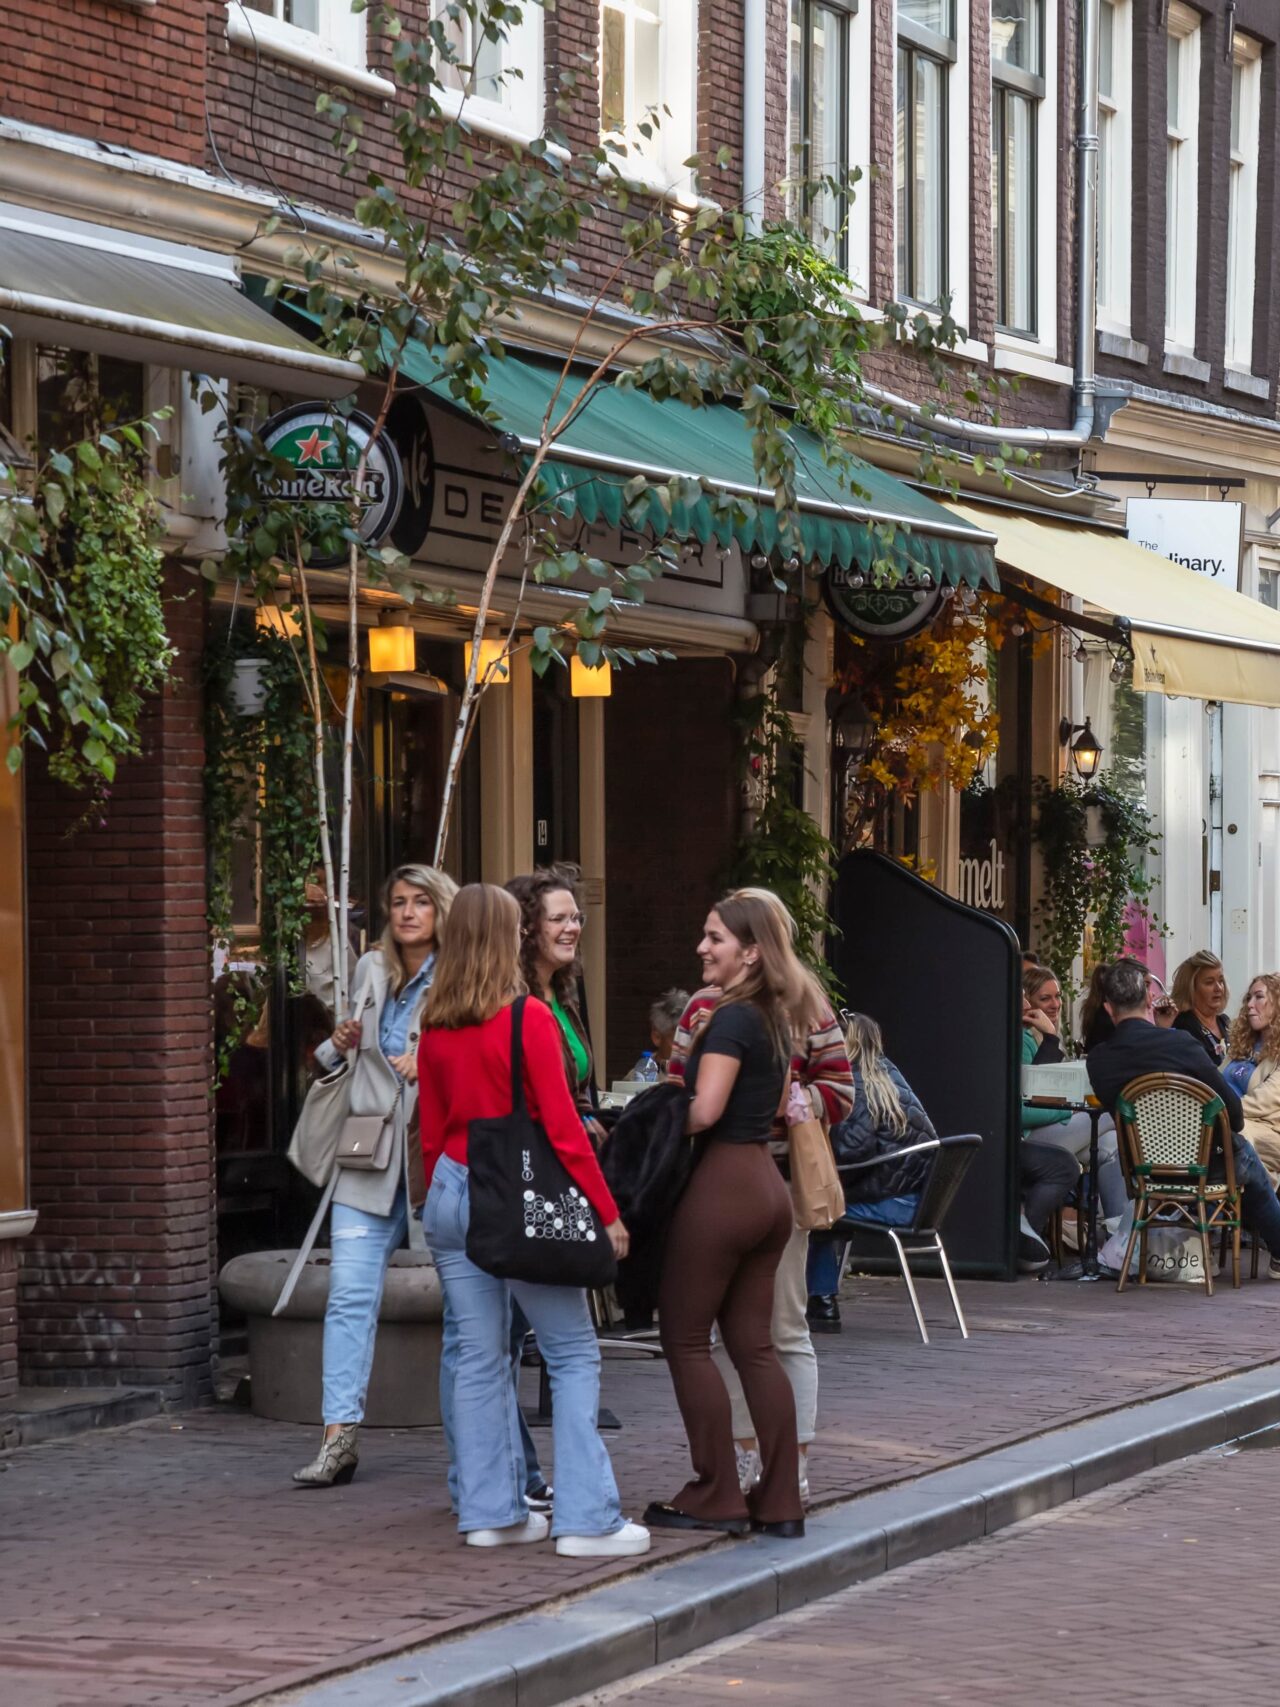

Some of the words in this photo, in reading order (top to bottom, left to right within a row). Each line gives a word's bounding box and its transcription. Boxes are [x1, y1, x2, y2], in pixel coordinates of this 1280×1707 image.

[444, 485, 504, 526] DE
[1138, 540, 1158, 551] The
[959, 838, 1005, 909] melt
[1147, 1251, 1199, 1270] mode
